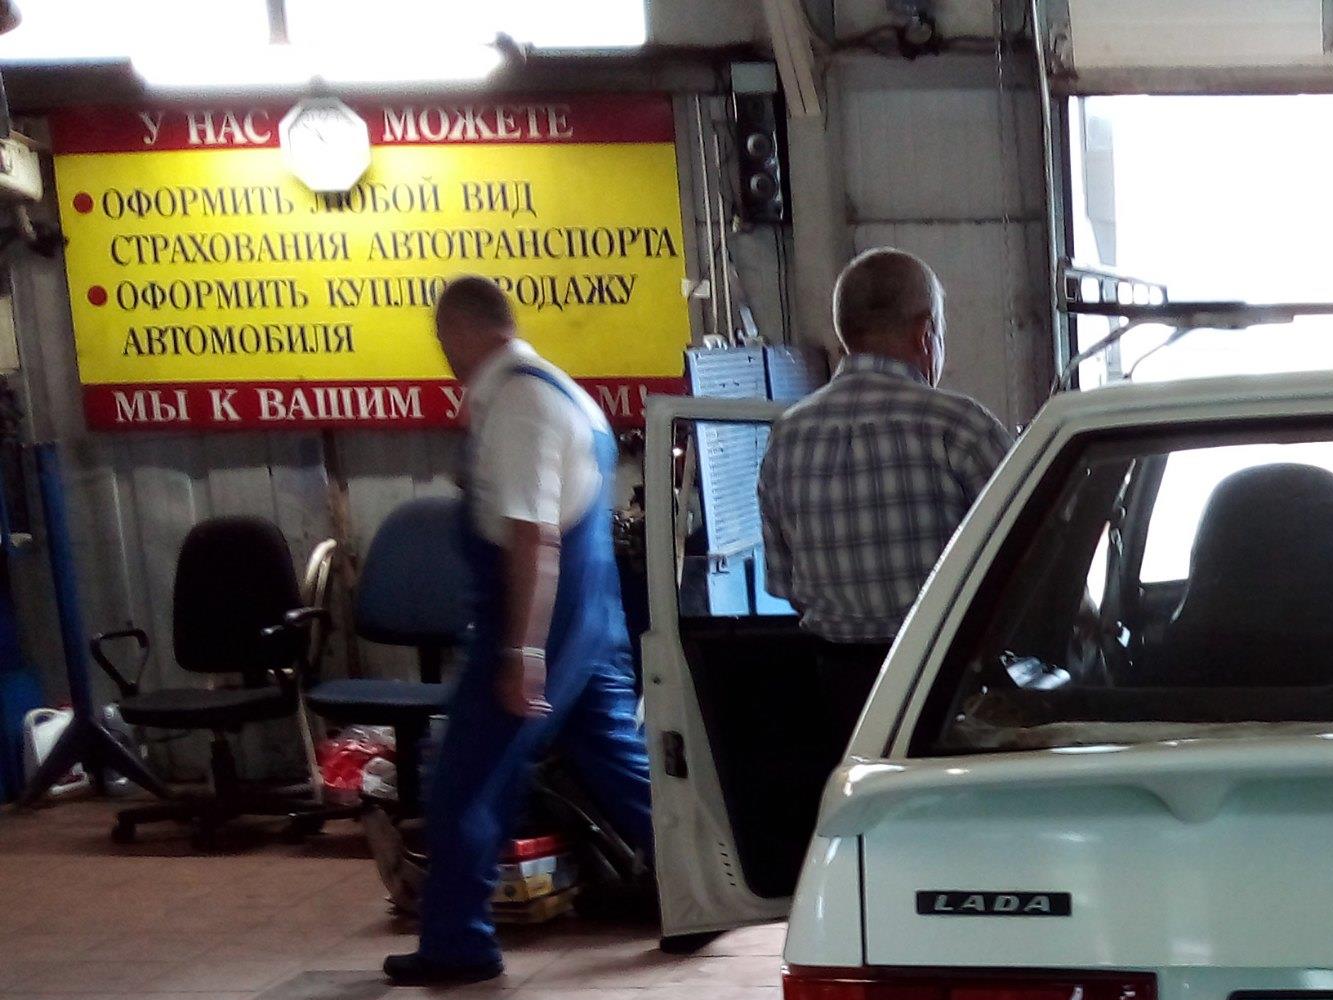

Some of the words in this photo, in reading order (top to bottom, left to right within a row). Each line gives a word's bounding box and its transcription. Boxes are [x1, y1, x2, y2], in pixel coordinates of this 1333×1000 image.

[138, 110, 164, 145] У
[186, 109, 271, 145] НАС
[383, 104, 574, 142] МОЖЕТЕ
[102, 187, 294, 220] ОФОРМИТЬ
[461, 180, 534, 218] ВИД
[111, 232, 351, 266] СТРАХОВАНИЯ
[367, 226, 678, 262] АВТОТРАНСПОРТА
[117, 279, 309, 311] ОФОРМИТЬ
[123, 324, 355, 357] АВТОМОБИЛЯ
[114, 390, 190, 423] МЫ
[209, 389, 242, 421] К
[257, 387, 423, 422] ВАШИМ
[934, 894, 1051, 913] LADA
